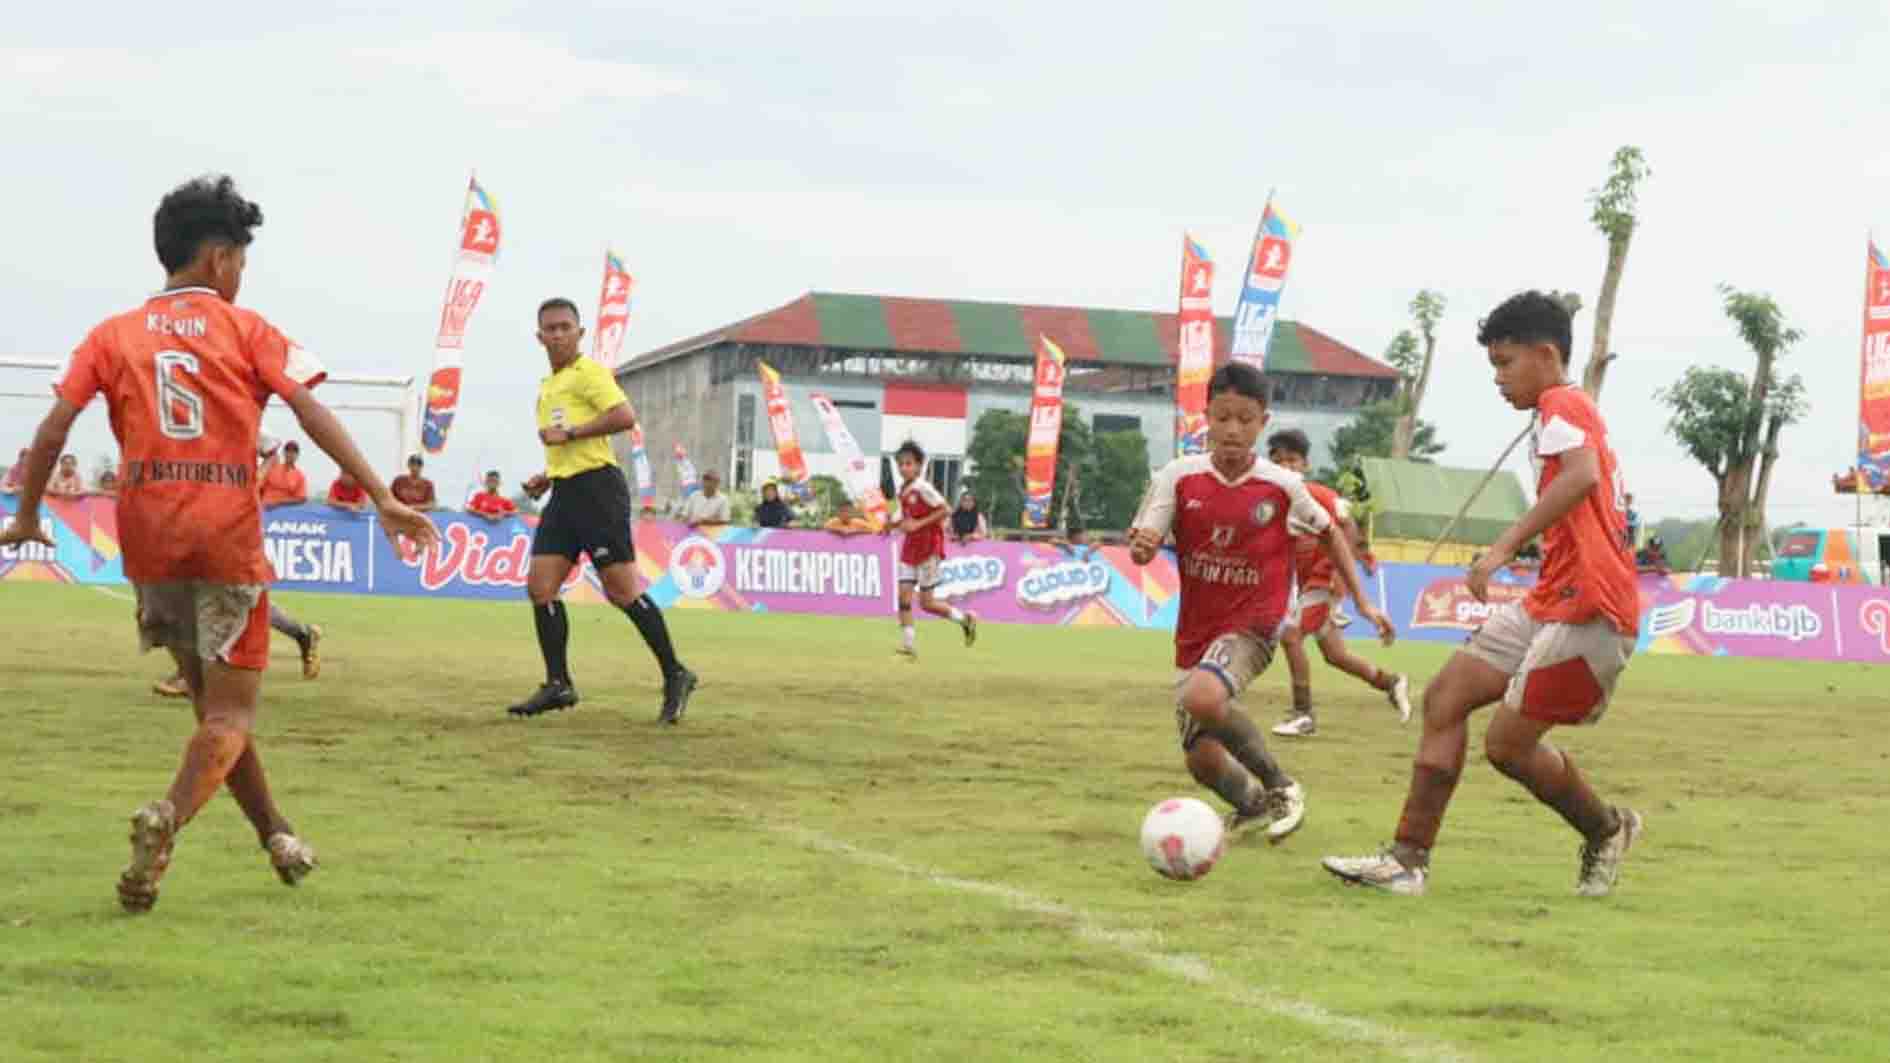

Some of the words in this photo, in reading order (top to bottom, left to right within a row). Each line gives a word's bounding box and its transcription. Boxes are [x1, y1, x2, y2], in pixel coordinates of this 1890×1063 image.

[154, 350, 204, 439] 6
[267, 519, 328, 535] ANAK
[263, 537, 353, 583] NESIA
[399, 522, 531, 591] Vid
[735, 548, 881, 597] KEMENPORA
[1702, 600, 1770, 634] bank
